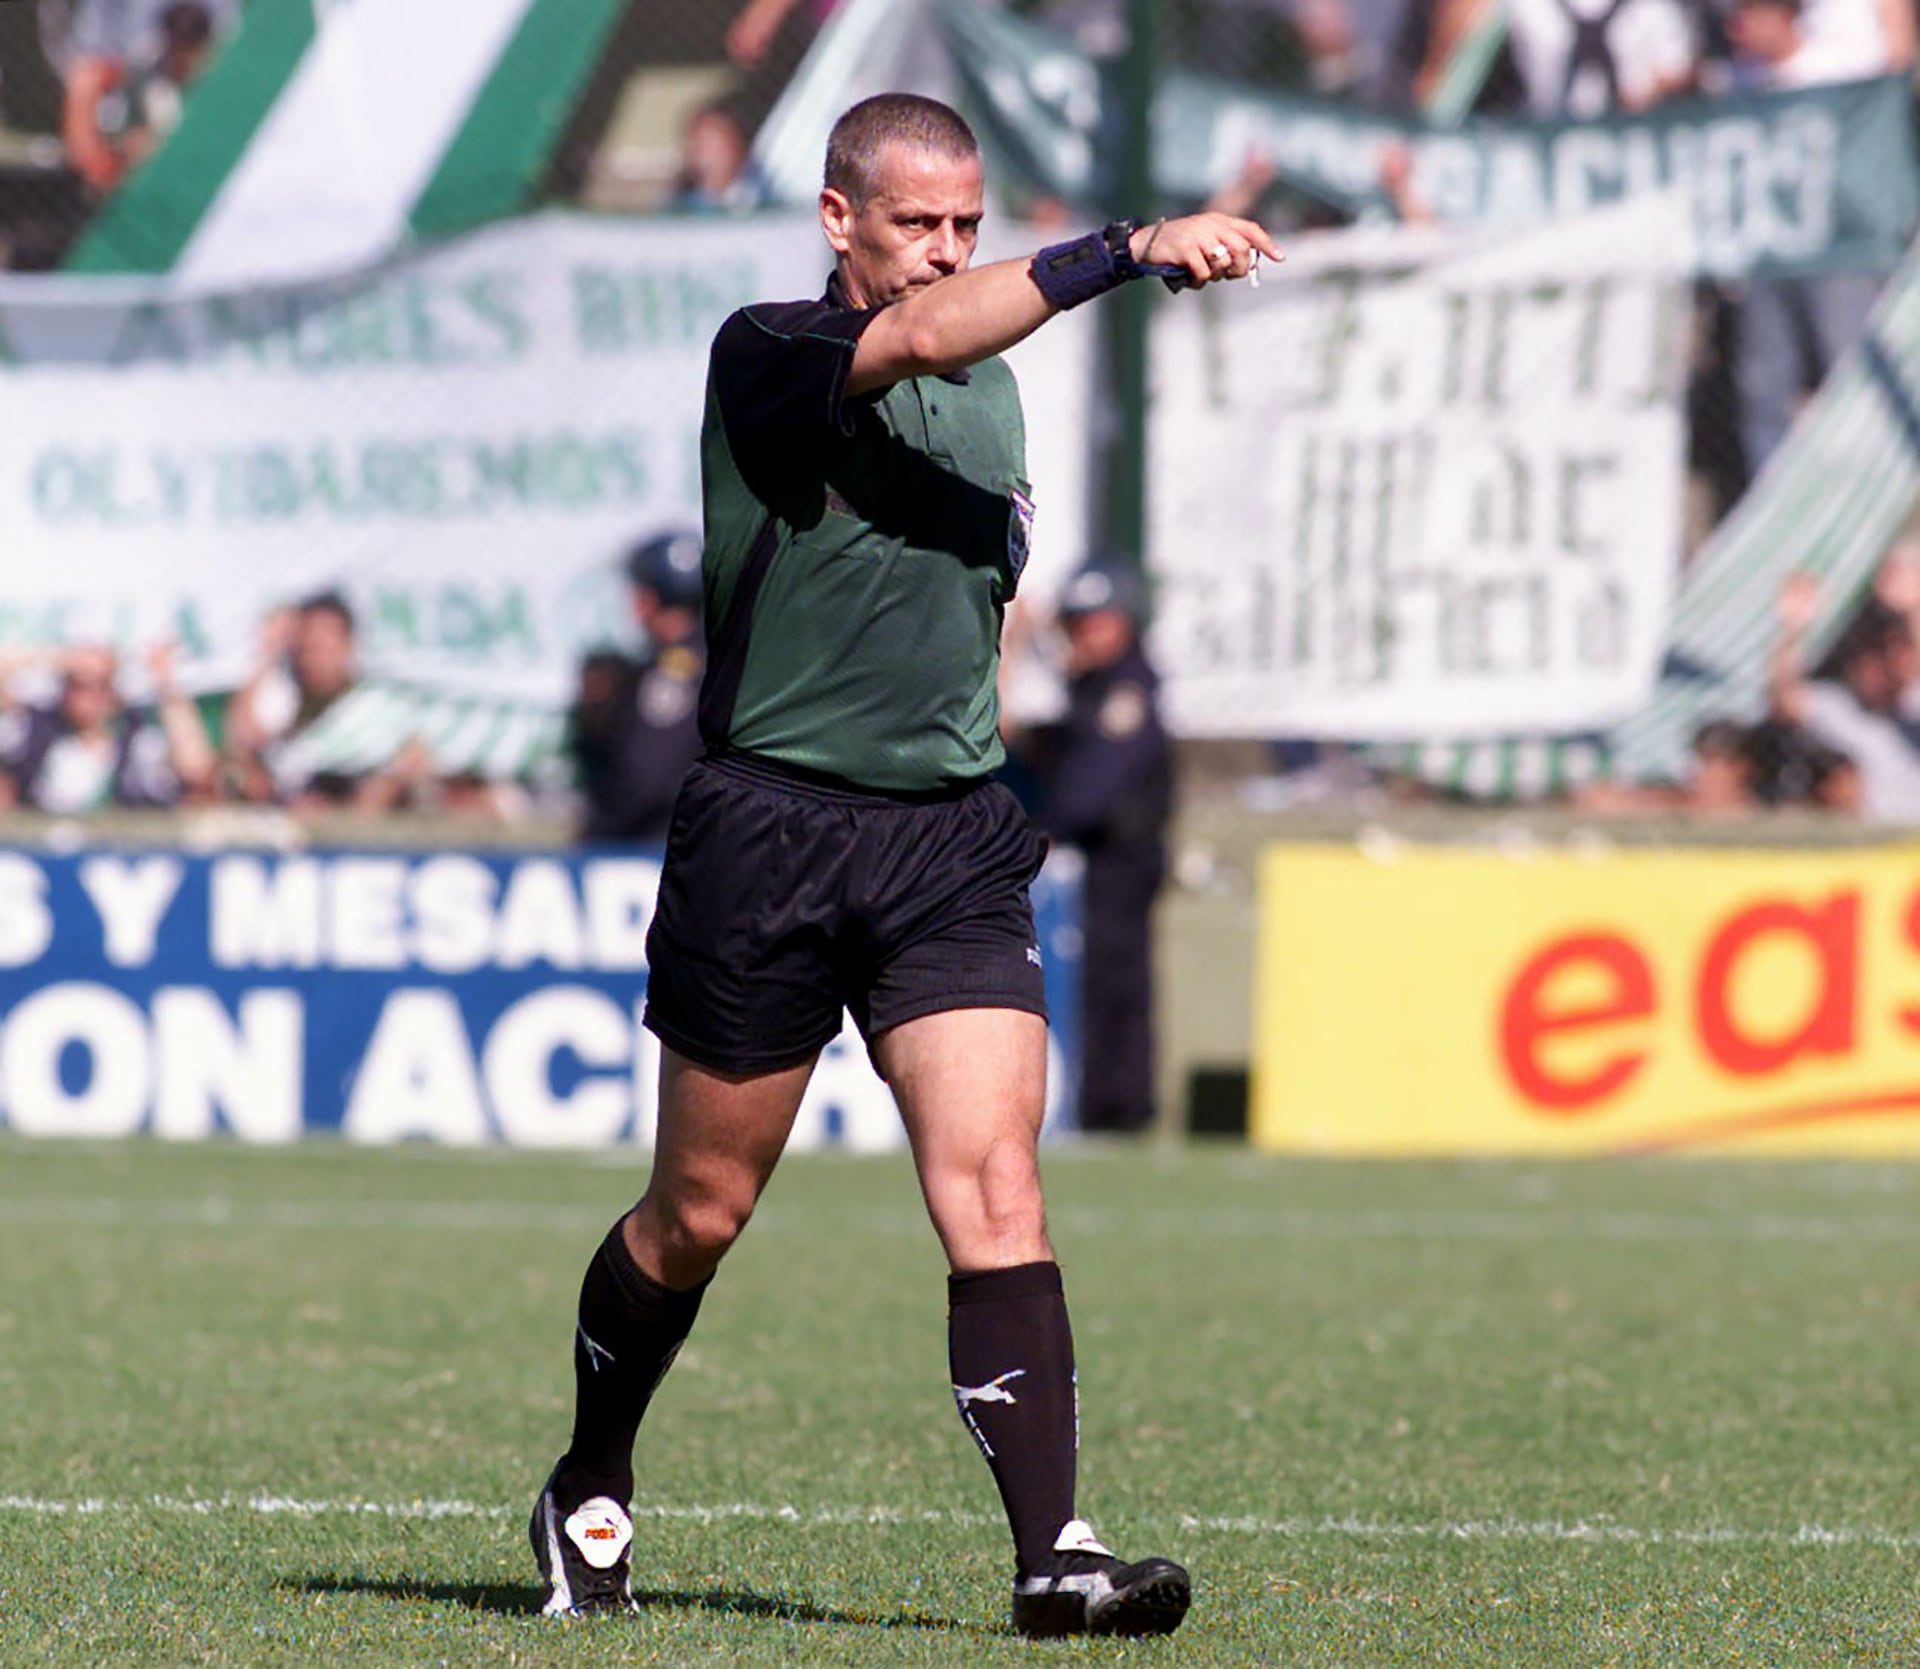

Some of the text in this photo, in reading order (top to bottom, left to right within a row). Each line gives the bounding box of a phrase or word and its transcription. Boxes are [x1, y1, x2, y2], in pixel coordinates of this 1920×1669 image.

[79, 857, 184, 968] Y
[2, 982, 305, 1144] ON
[1497, 886, 1920, 1116] ea
